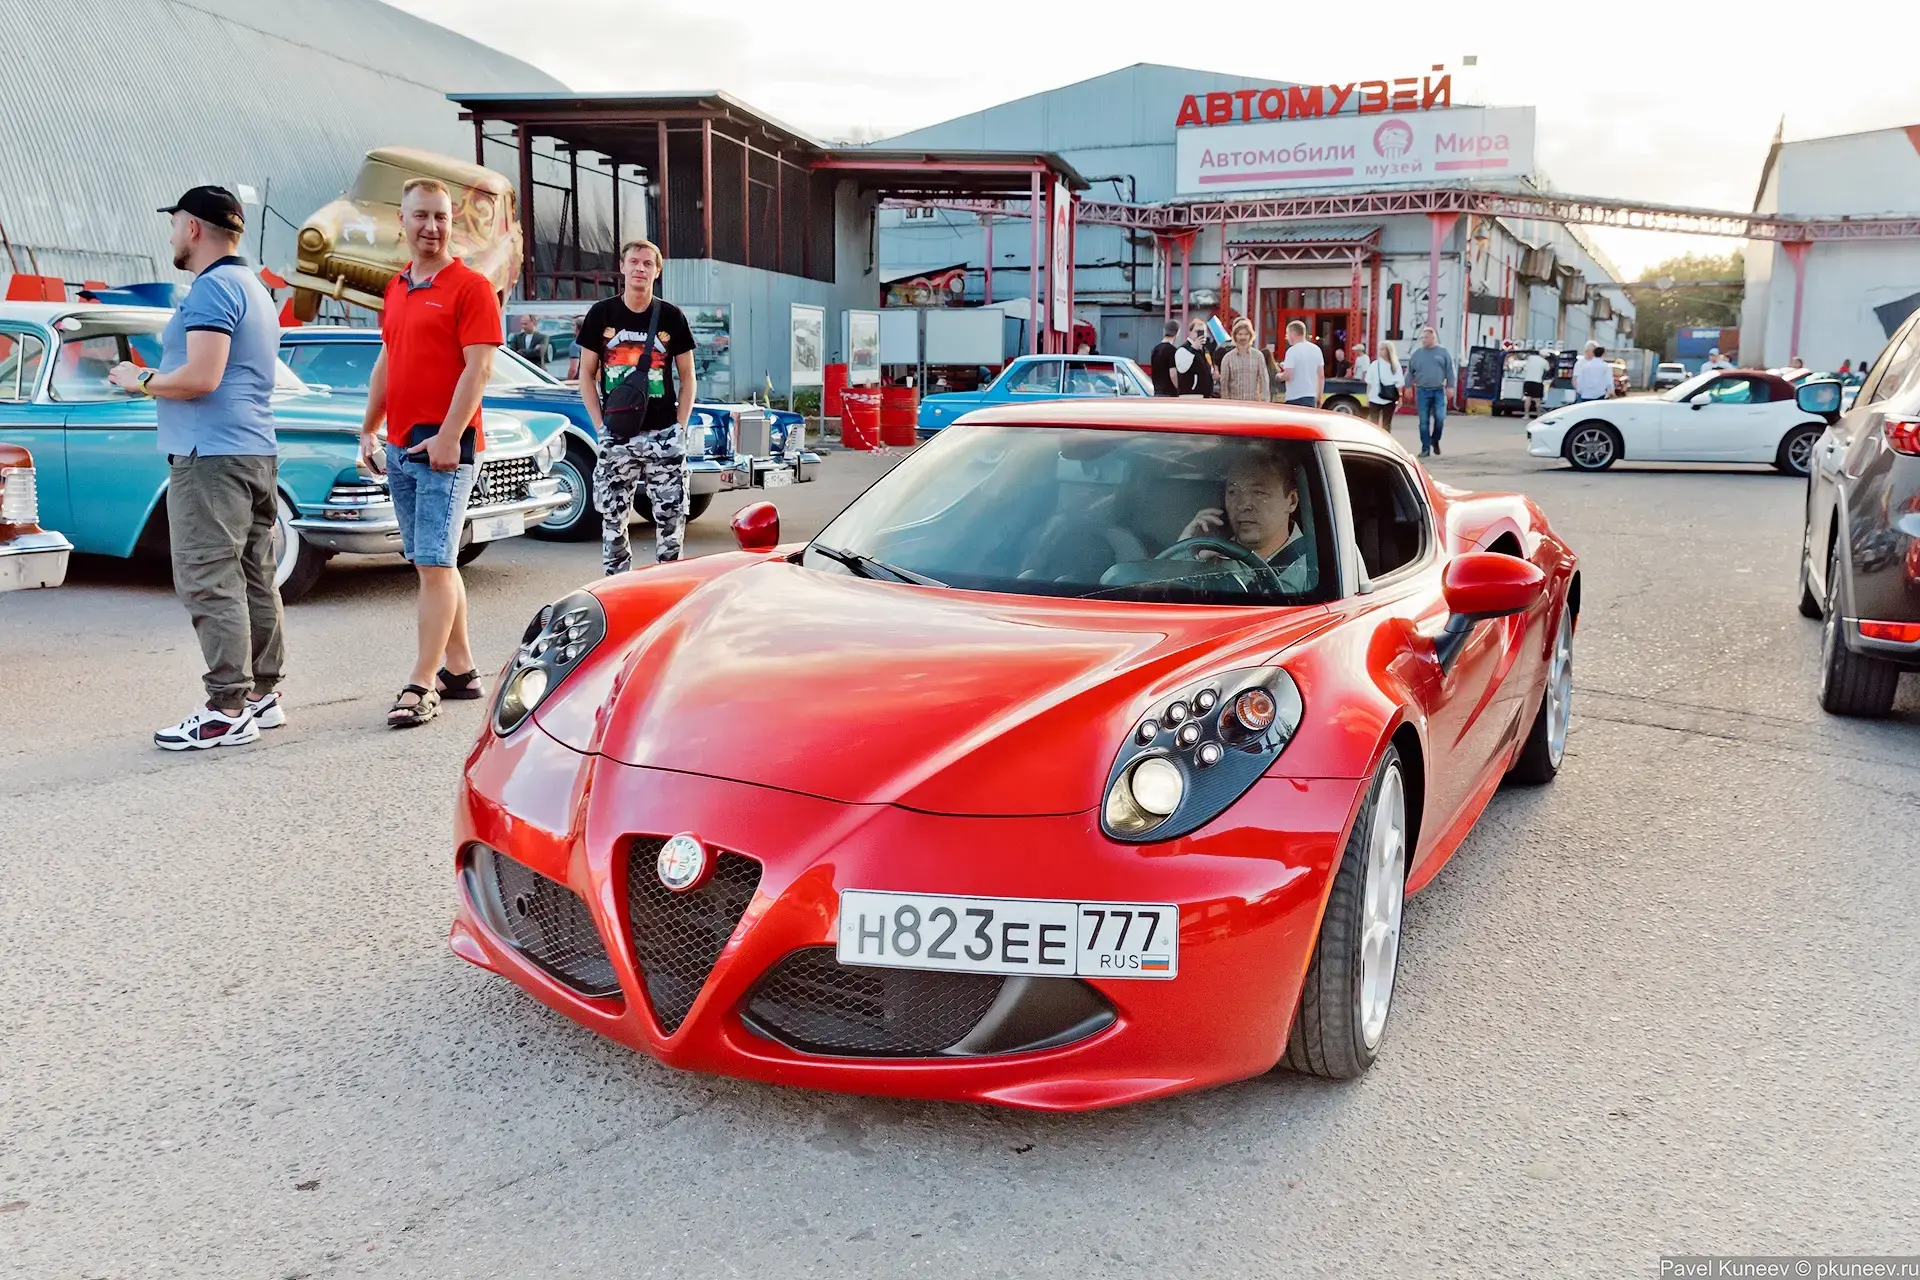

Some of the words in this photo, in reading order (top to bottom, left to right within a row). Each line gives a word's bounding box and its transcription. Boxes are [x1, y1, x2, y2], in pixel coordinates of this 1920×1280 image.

[1176, 64, 1451, 127] АВТОМУЗЕЙ
[1199, 142, 1355, 169] Автомобили
[1434, 131, 1510, 157] Мира
[1365, 158, 1423, 179] музей
[1083, 909, 1161, 952] 777
[1100, 954, 1139, 970] RUS
